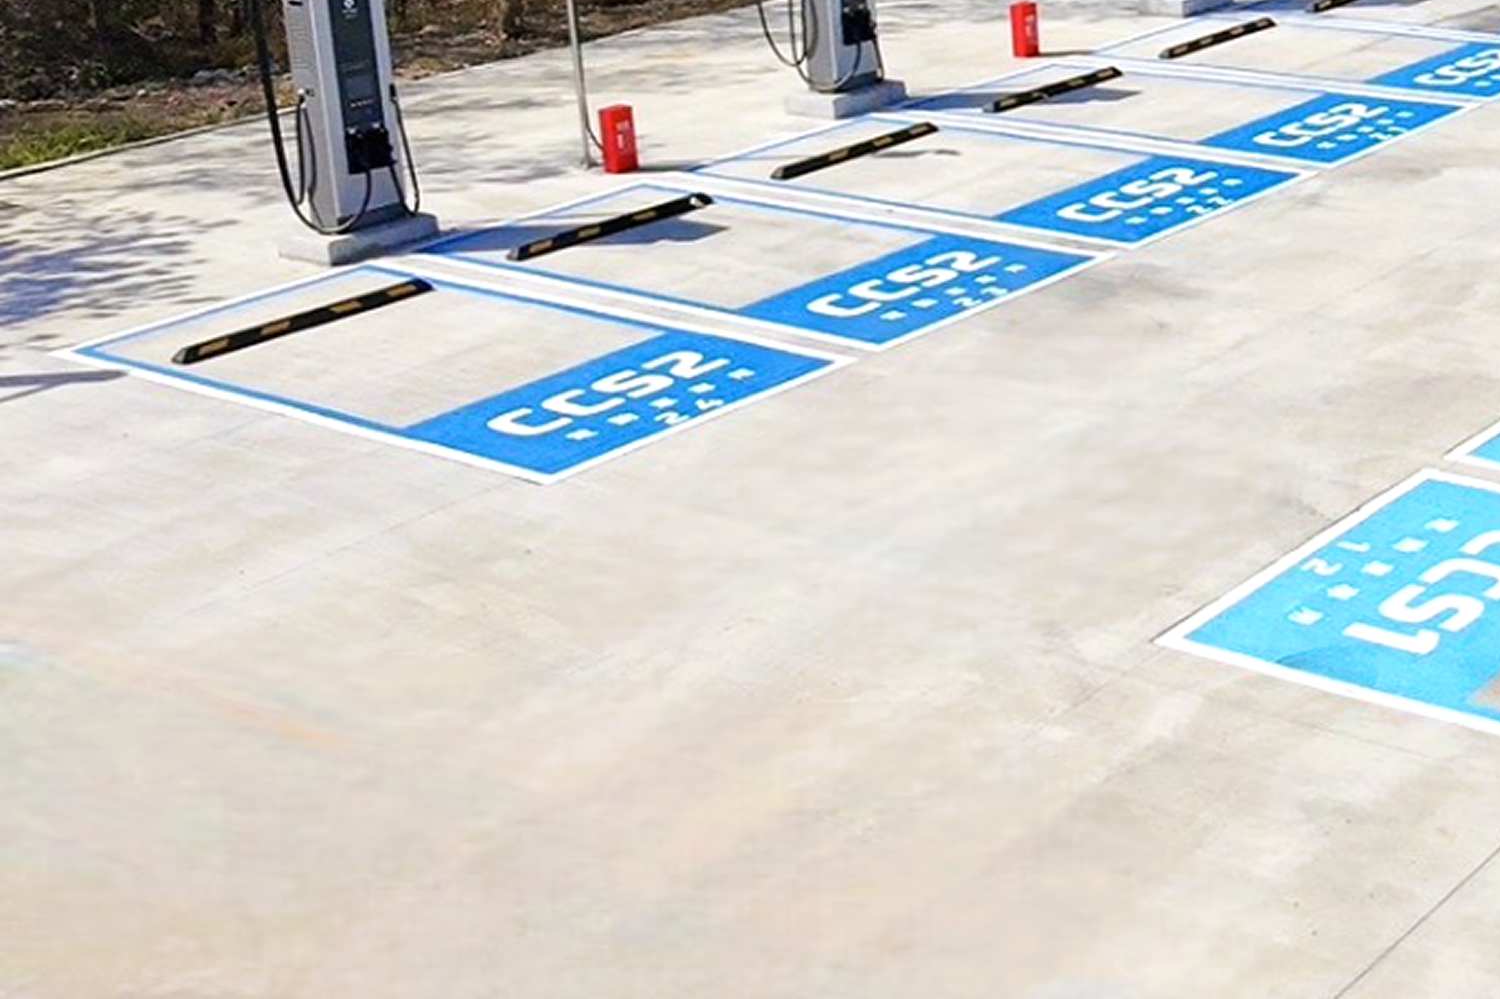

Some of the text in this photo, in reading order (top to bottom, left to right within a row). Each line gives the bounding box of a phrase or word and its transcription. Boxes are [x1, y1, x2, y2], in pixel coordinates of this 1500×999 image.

[1252, 102, 1390, 147] CCS2
[1056, 167, 1219, 222] CCS2
[806, 250, 1001, 318] CCS2
[487, 350, 731, 437] CCS2
[655, 398, 724, 426] 24
[1302, 540, 1371, 577] 12
